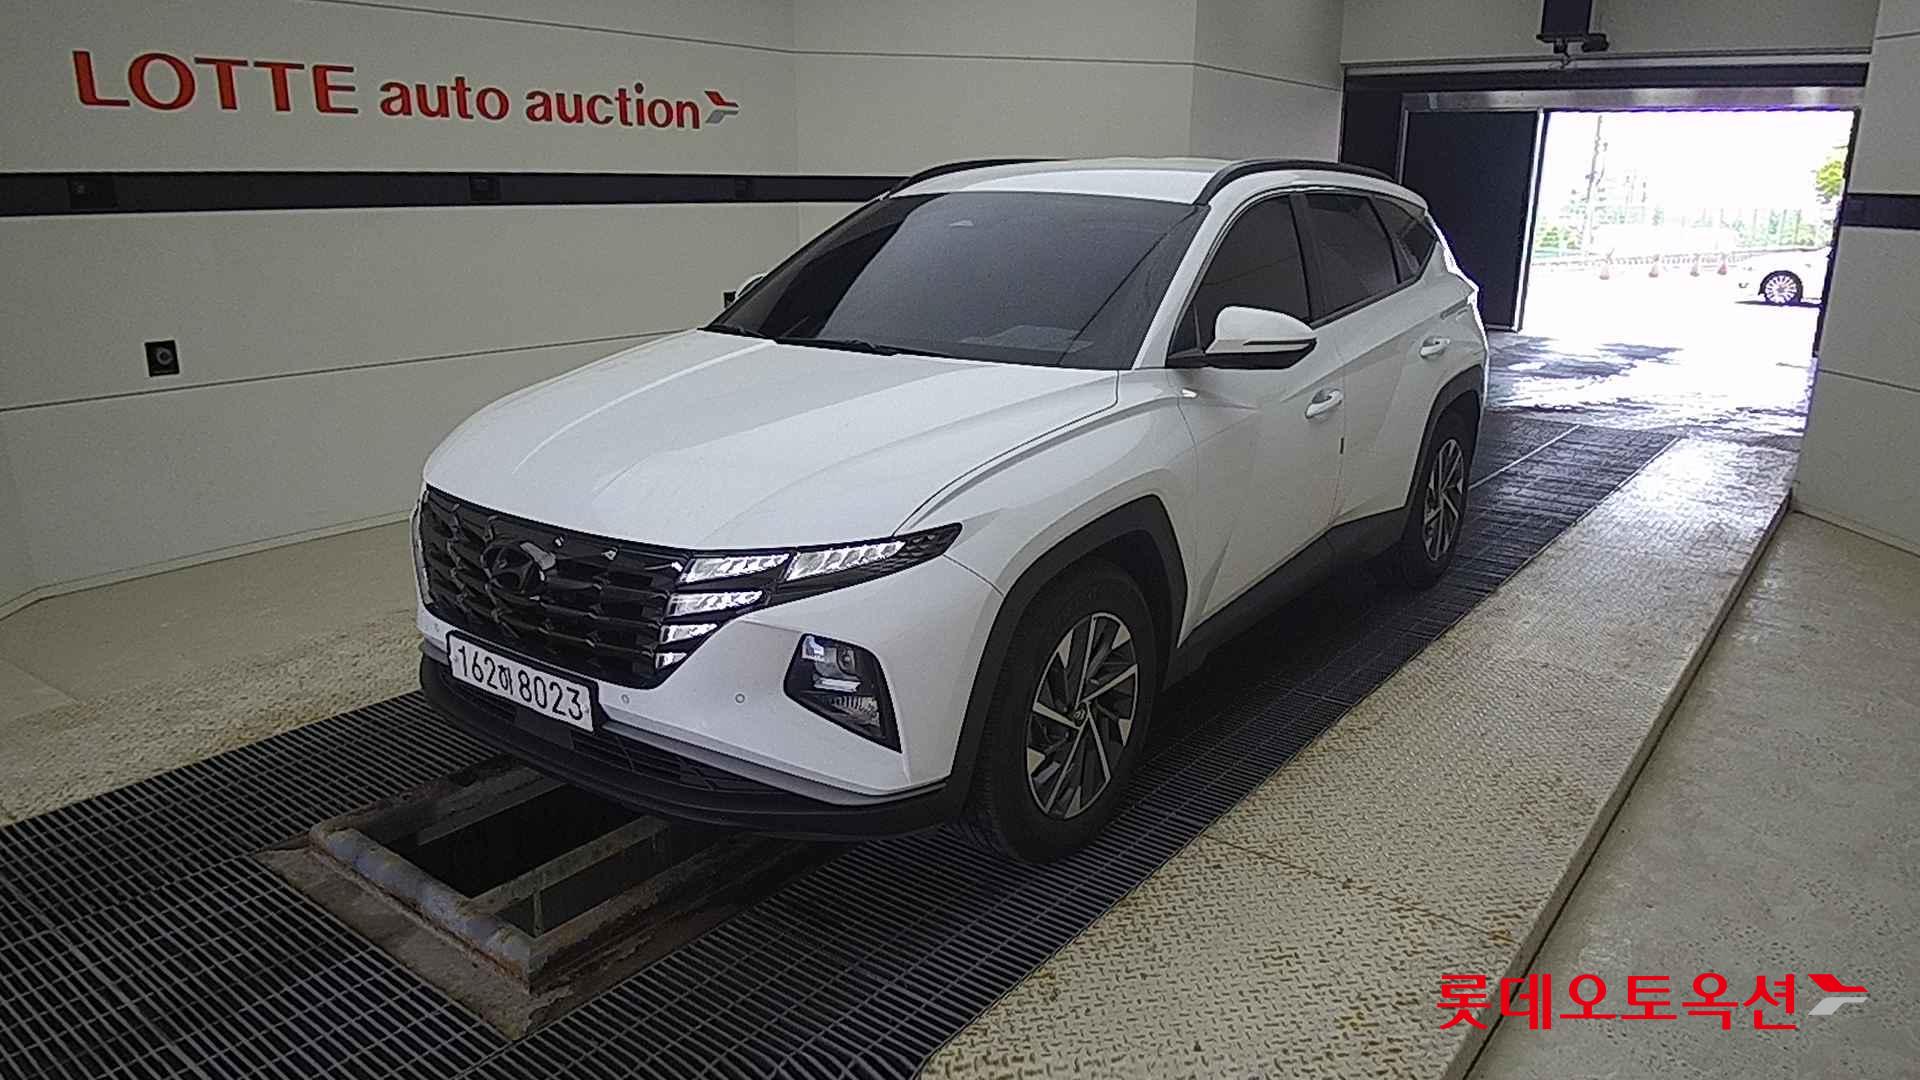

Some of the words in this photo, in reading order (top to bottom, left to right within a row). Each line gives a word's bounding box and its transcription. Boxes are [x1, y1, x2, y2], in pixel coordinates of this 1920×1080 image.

[73, 50, 358, 115] LOTTE
[379, 76, 510, 121] auto
[525, 81, 701, 130] auction
